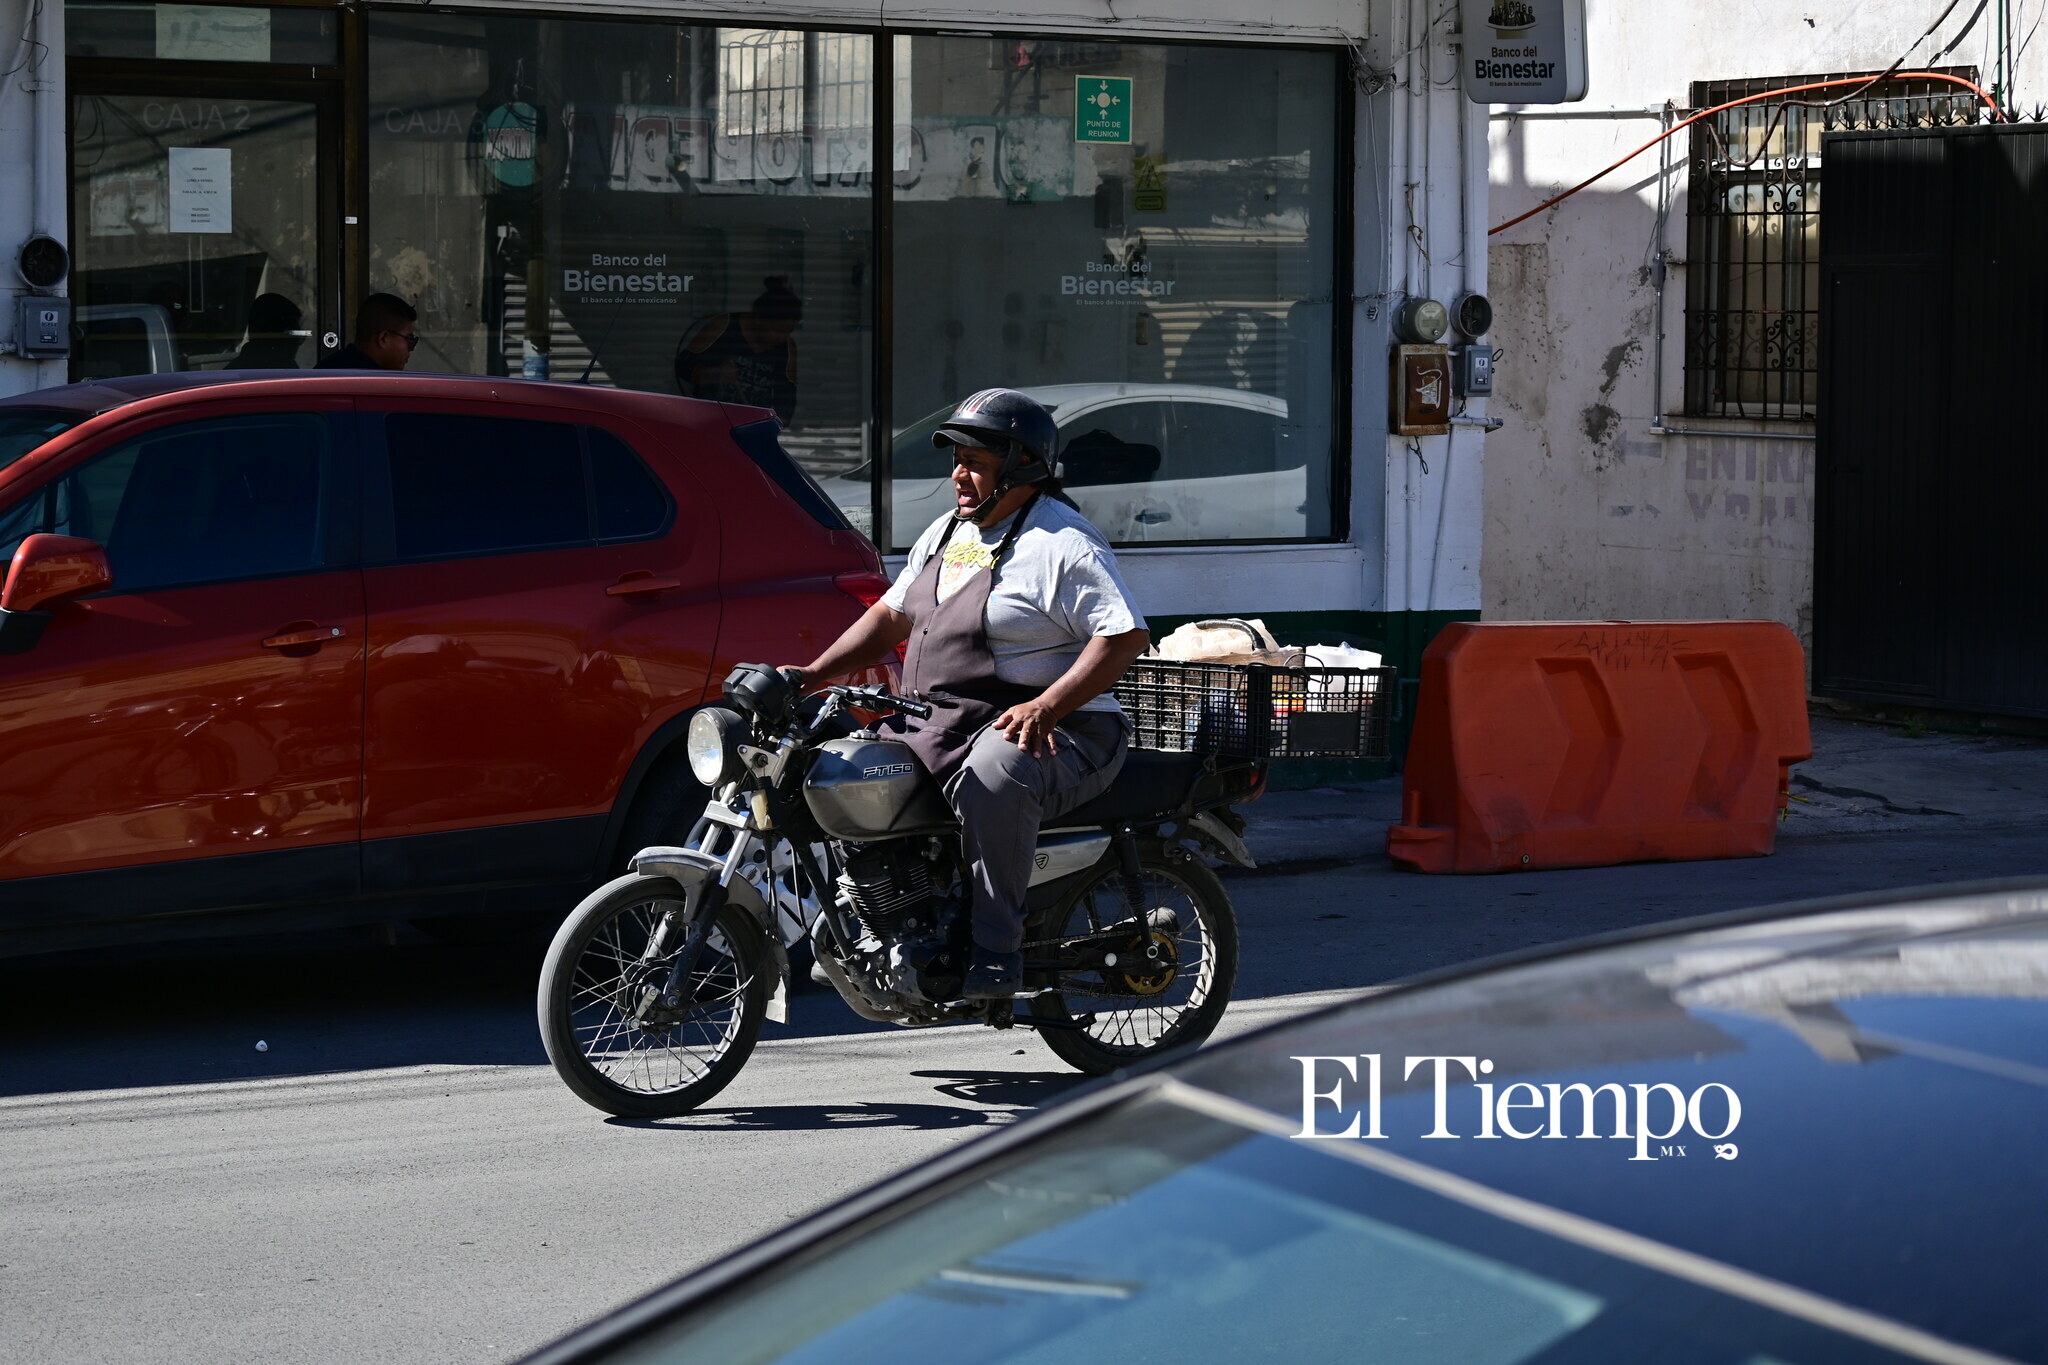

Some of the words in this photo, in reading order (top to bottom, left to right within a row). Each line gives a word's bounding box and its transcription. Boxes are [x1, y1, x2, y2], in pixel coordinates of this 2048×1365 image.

[1491, 46, 1521, 58] Banco
[1523, 46, 1538, 57] del
[1475, 59, 1555, 79] Bienestar
[143, 102, 227, 130] CAJA
[233, 104, 251, 130] 2
[384, 107, 464, 135] CAJA
[1086, 120, 1111, 128] PUNTO
[1111, 121, 1122, 129] DE
[1088, 130, 1120, 138] REUNION
[591, 253, 640, 267] Banco
[643, 253, 667, 267] del
[1086, 261, 1128, 273] Banco
[1131, 261, 1152, 273] del
[564, 269, 694, 292] Bienestar
[1061, 275, 1176, 296] Bienestar
[581, 296, 589, 304] El
[590, 296, 613, 304] banco
[614, 296, 624, 304] de
[625, 296, 636, 304] los
[638, 296, 678, 304] mexicanos
[862, 762, 914, 780] FT150
